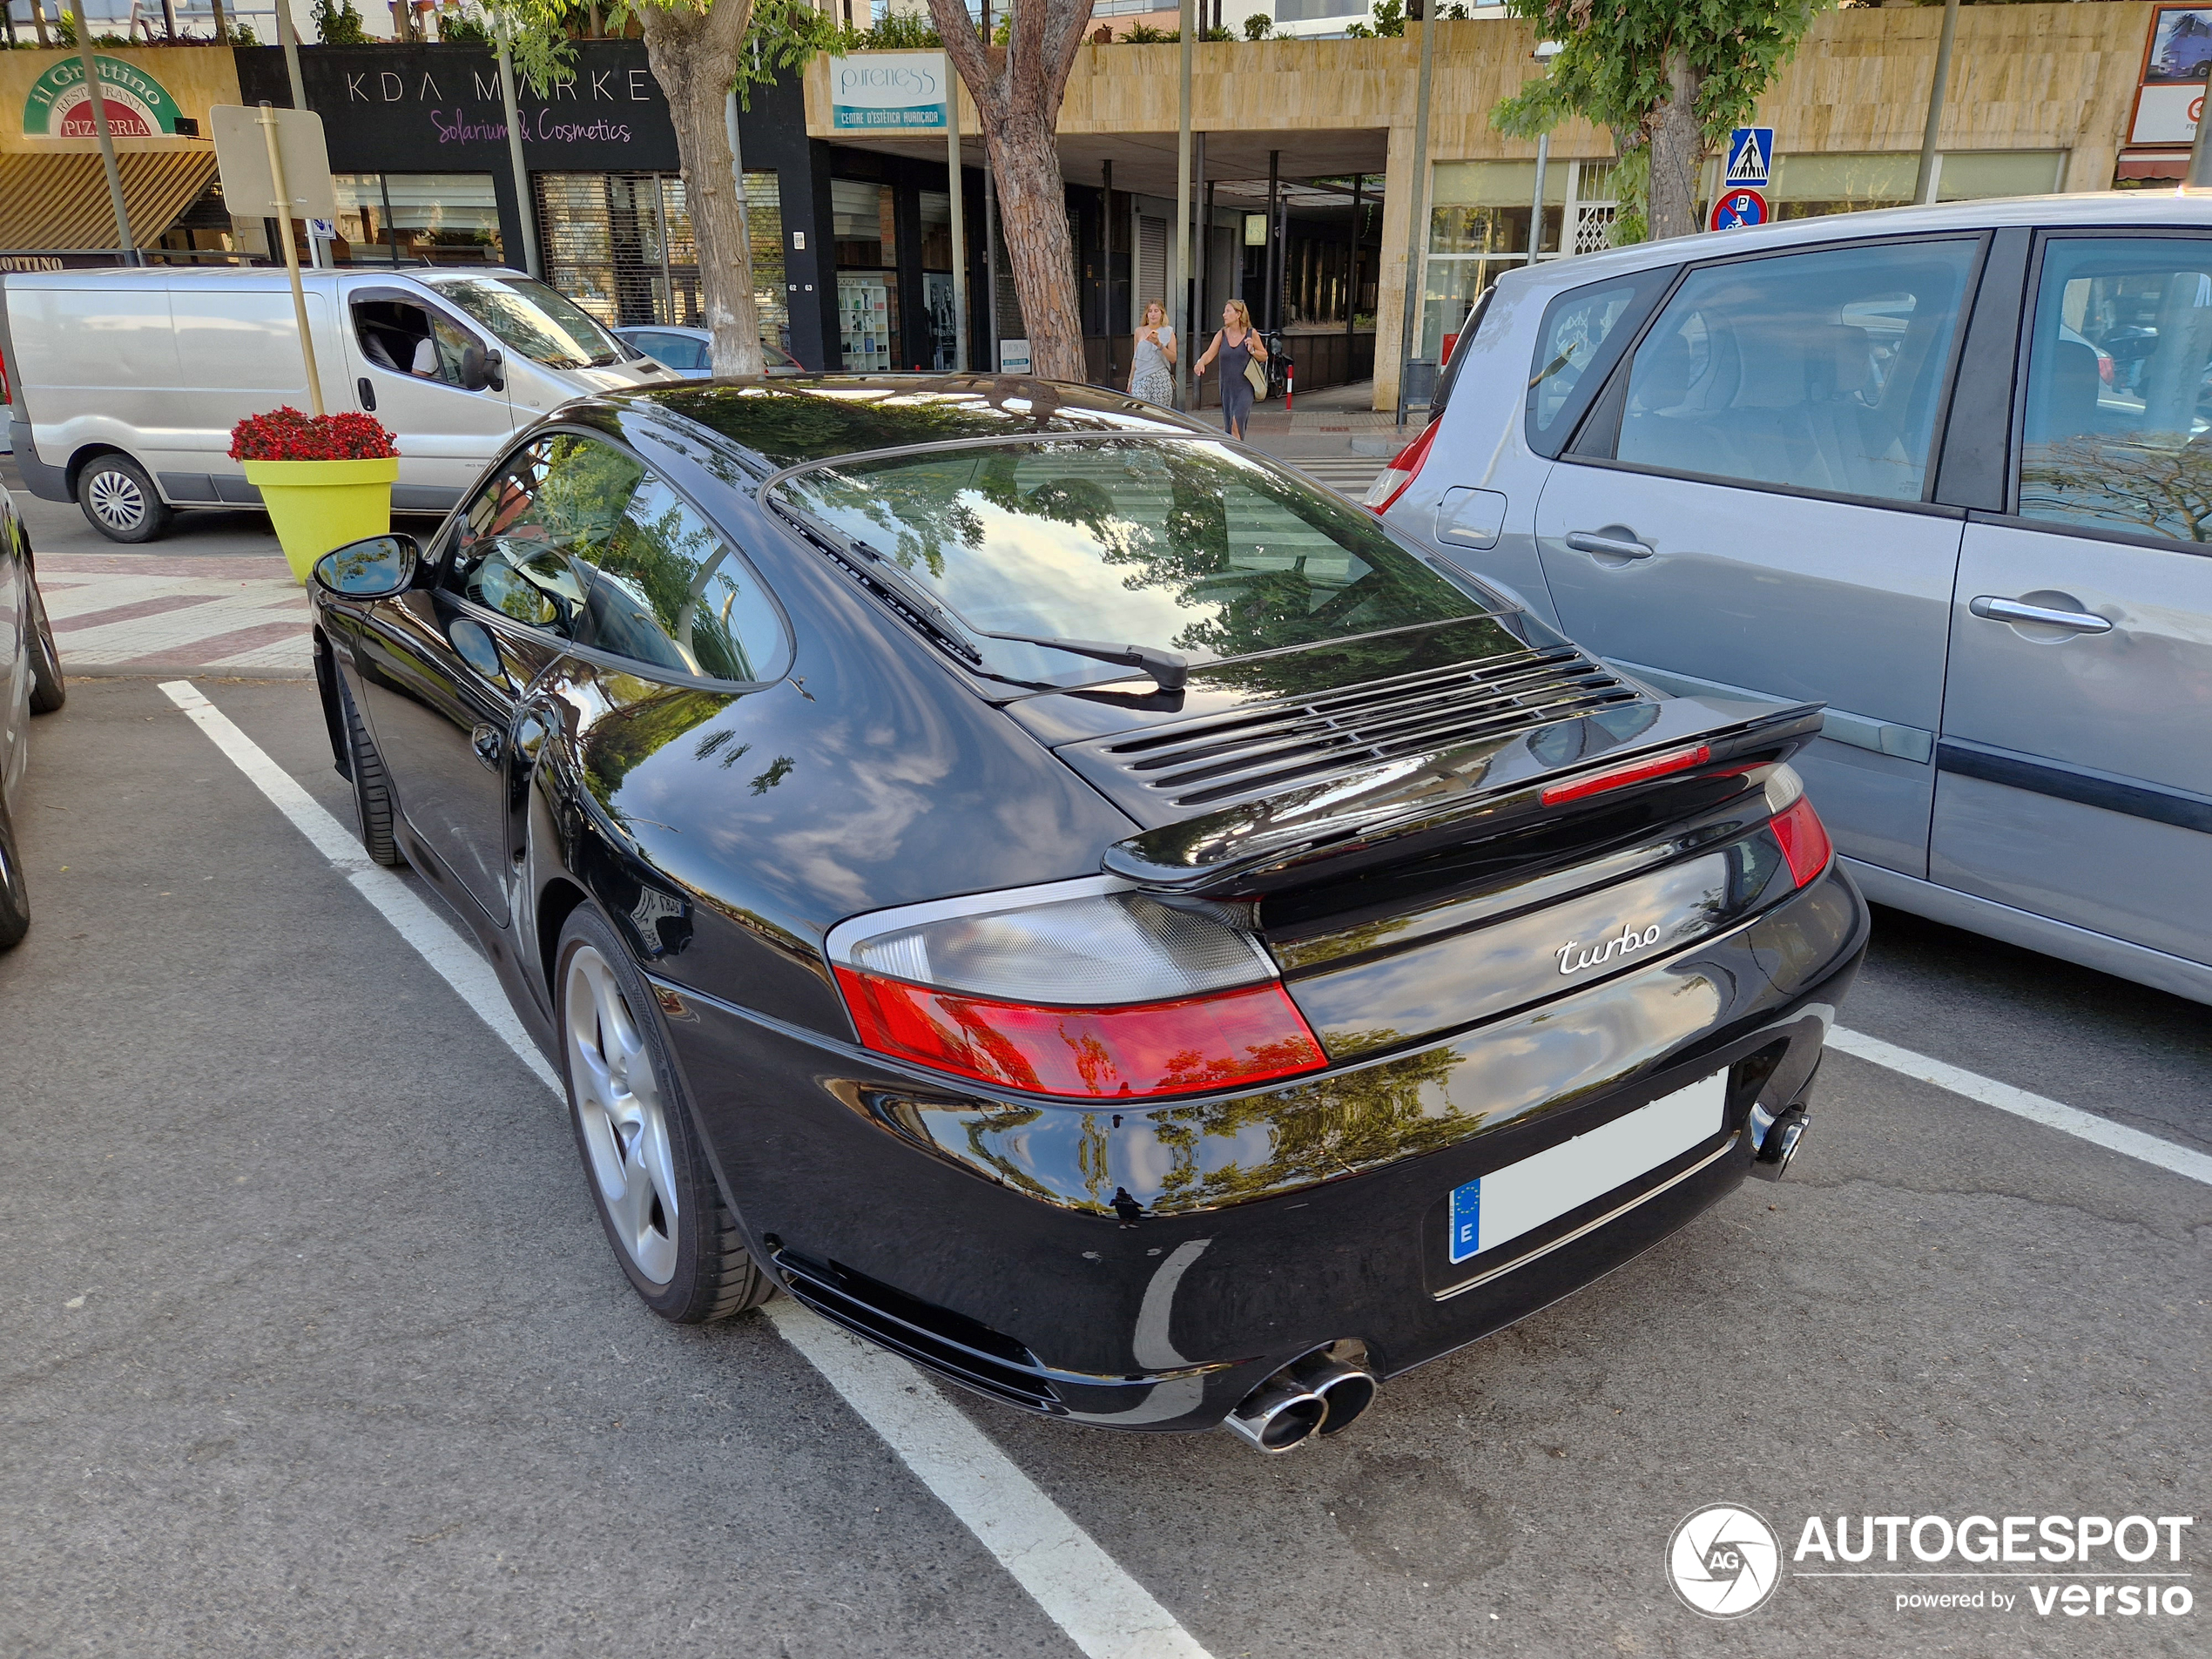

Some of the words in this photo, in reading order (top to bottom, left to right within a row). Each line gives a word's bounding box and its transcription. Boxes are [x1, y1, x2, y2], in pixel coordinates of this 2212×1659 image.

[430, 107, 509, 145] Solarium
[516, 109, 534, 142] &
[538, 107, 632, 143] Cosmetics
[841, 111, 864, 125] CENTRE
[903, 111, 939, 125] AVANÇADA
[1737, 197, 1747, 209] P
[1554, 923, 1661, 975] turbo
[1461, 1223, 1473, 1244] E
